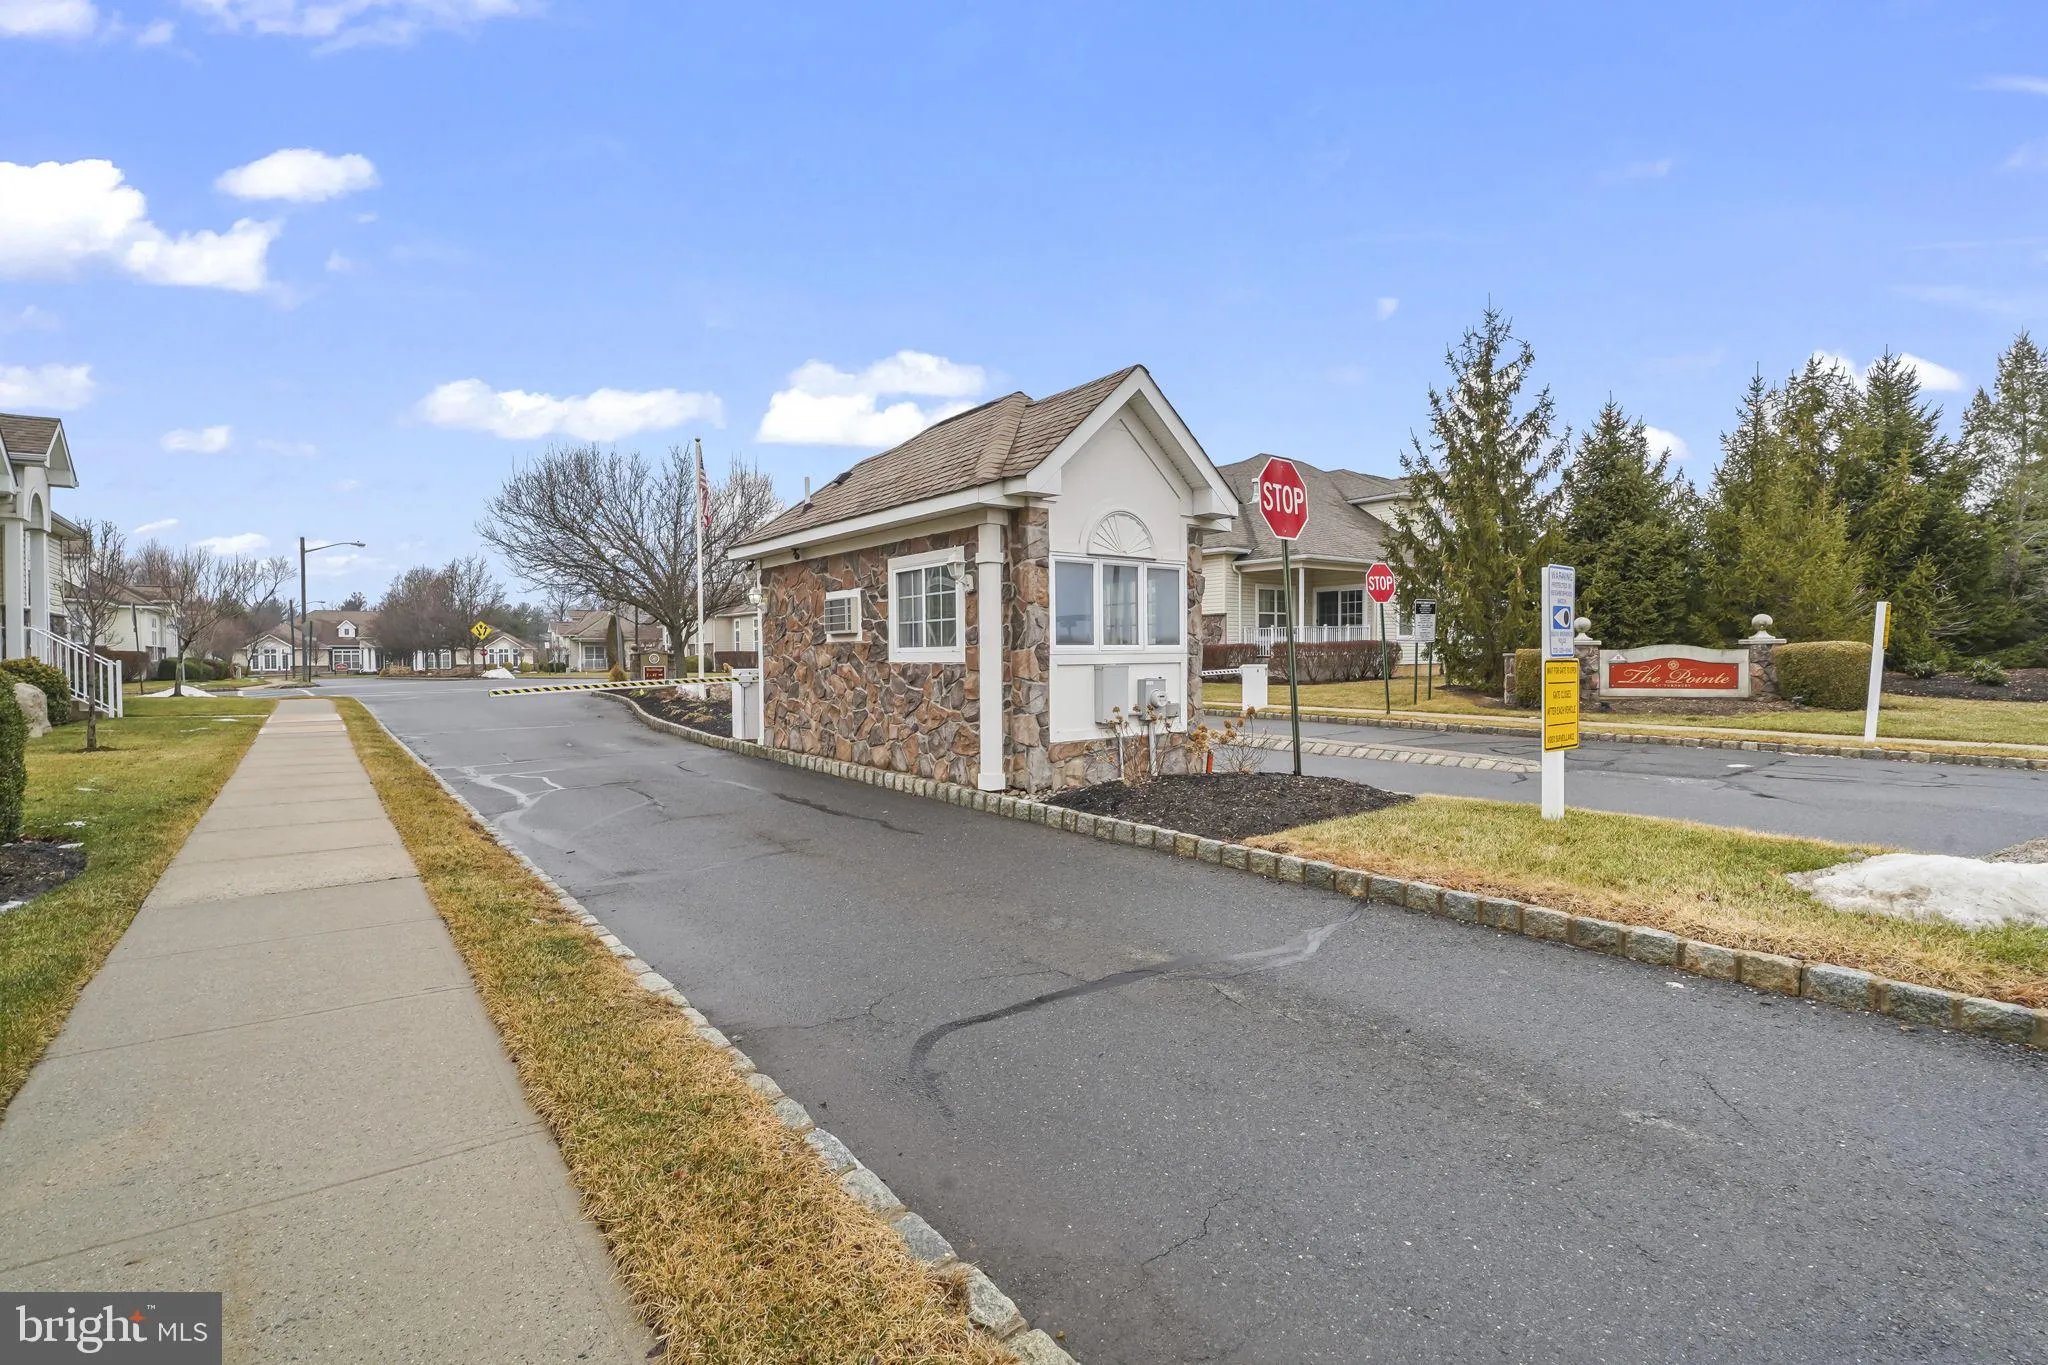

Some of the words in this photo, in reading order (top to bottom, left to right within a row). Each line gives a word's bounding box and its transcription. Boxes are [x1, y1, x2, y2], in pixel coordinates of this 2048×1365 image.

[1263, 481, 1304, 515] STOP
[1368, 575, 1393, 591] STOP
[1618, 665, 1661, 684] The
[1665, 669, 1730, 684] Pointe
